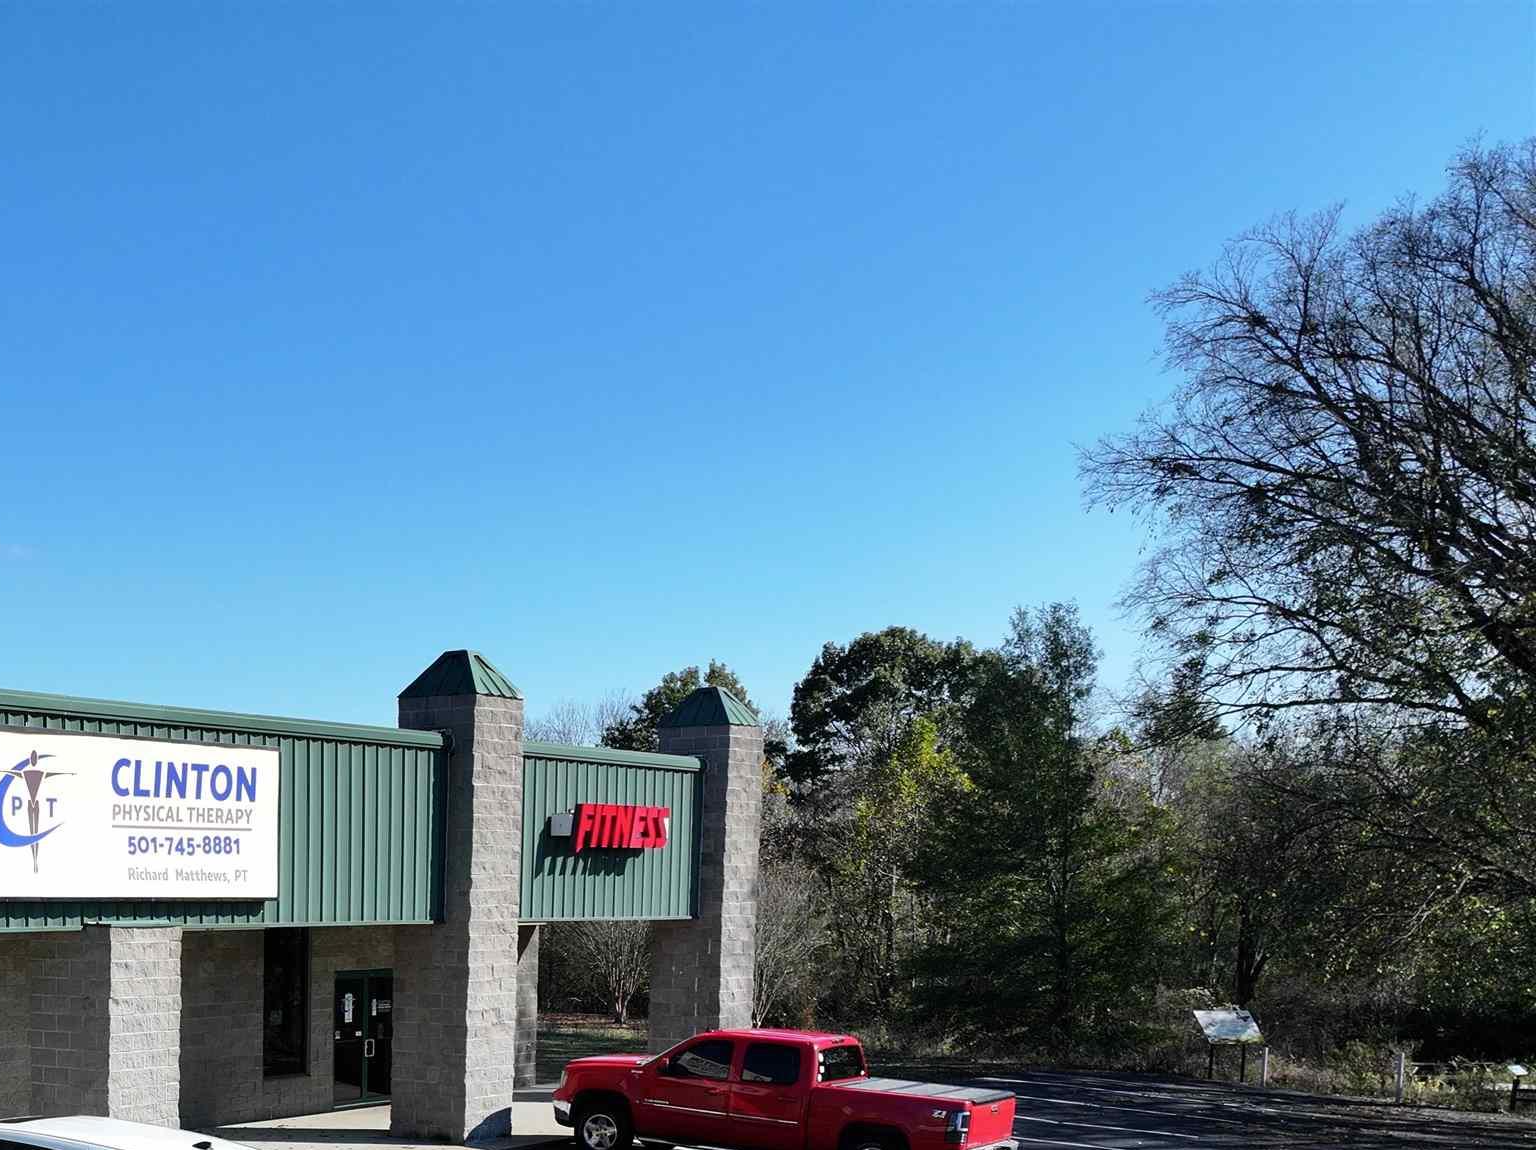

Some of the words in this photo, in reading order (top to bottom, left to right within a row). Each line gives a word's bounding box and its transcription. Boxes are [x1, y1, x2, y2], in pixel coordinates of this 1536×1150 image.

[111, 758, 257, 802] CLINTON
[112, 804, 183, 823] PHYSICAL
[187, 807, 253, 825] THERAPY
[575, 803, 670, 853] FITNESS
[127, 836, 241, 856] 501-745-8881
[128, 867, 169, 882] Richard
[175, 867, 230, 884] Matthews,
[234, 869, 249, 882] PT
